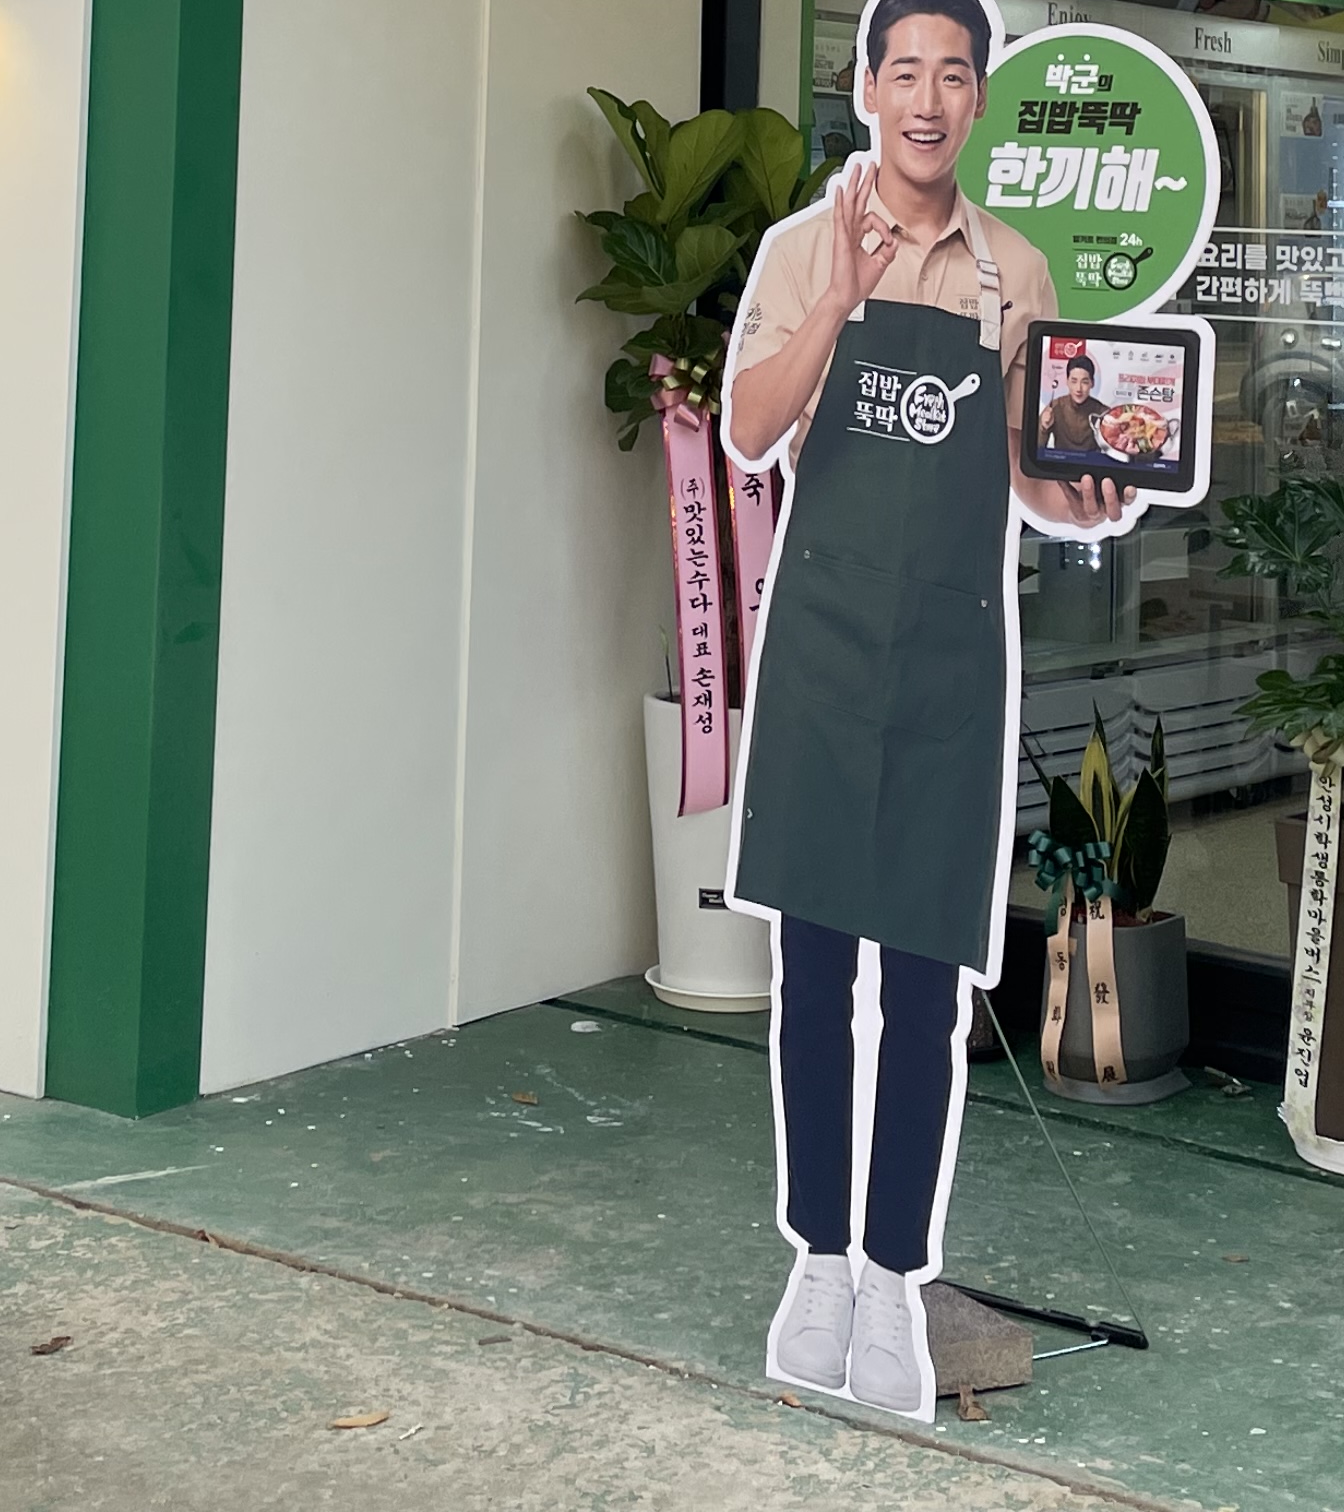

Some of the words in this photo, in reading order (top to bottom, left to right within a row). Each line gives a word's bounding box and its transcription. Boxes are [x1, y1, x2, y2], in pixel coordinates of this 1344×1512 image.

[1194, 27, 1232, 53] Fresh
[1044, 64, 1114, 95] 박군의
[1017, 100, 1142, 135] 집밥뚝딱
[985, 141, 1188, 213] 한끼해~
[1119, 232, 1143, 246] 24h
[1076, 253, 1103, 270] 집밥
[1196, 275, 1291, 305] 간편하게
[858, 370, 902, 402] 집밥
[854, 400, 898, 433] 뚝딱
[690, 625, 713, 658] 대표
[690, 666, 716, 735] 손재성
